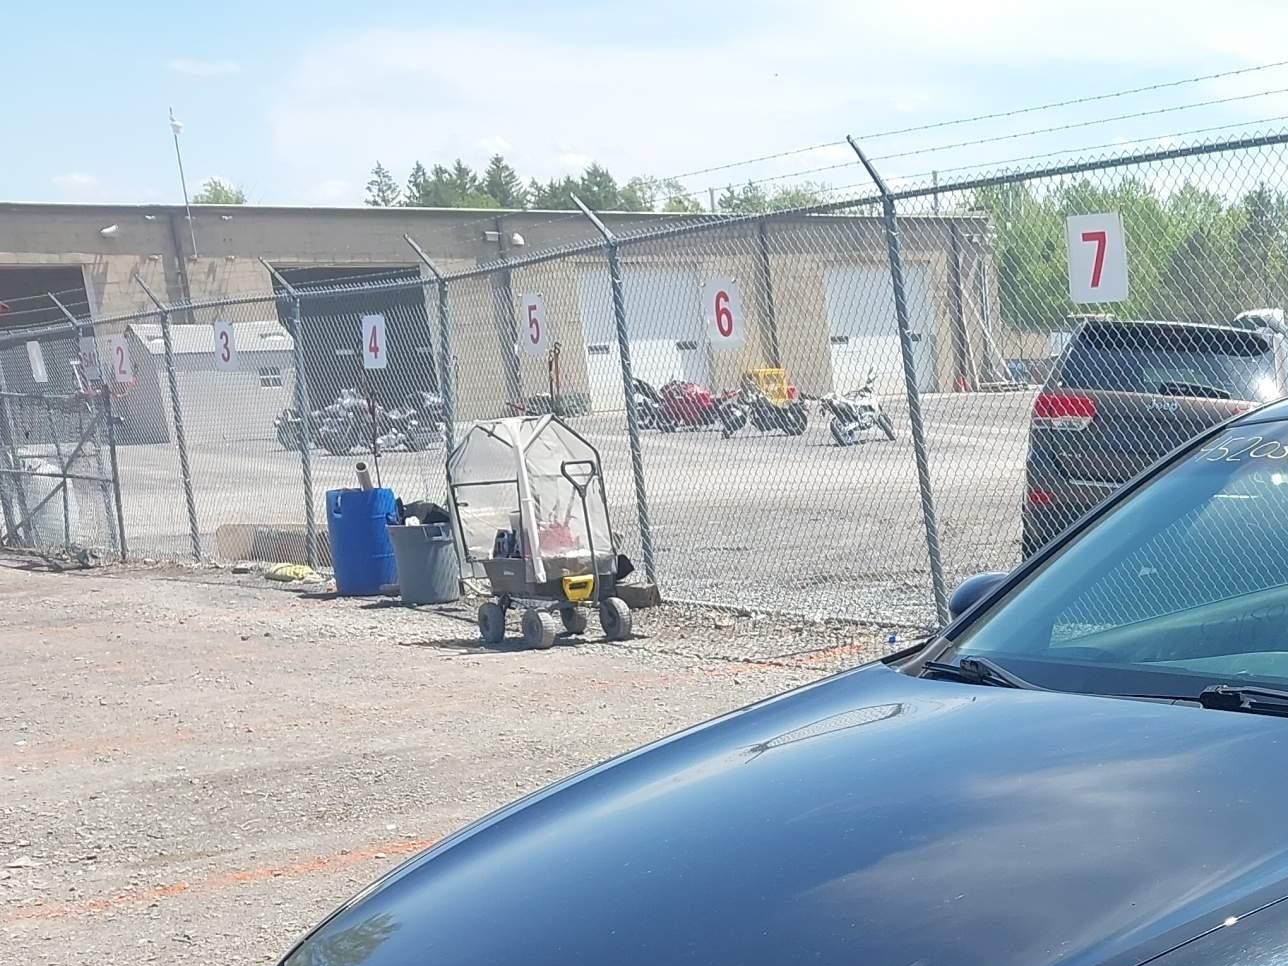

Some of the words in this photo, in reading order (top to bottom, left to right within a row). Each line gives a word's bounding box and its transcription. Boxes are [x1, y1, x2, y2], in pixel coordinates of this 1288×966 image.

[1081, 230, 1108, 288] 7
[527, 304, 541, 345] 5
[714, 290, 735, 338] 6
[115, 346, 127, 375] 2
[219, 330, 231, 363] 3
[368, 324, 380, 360] 4
